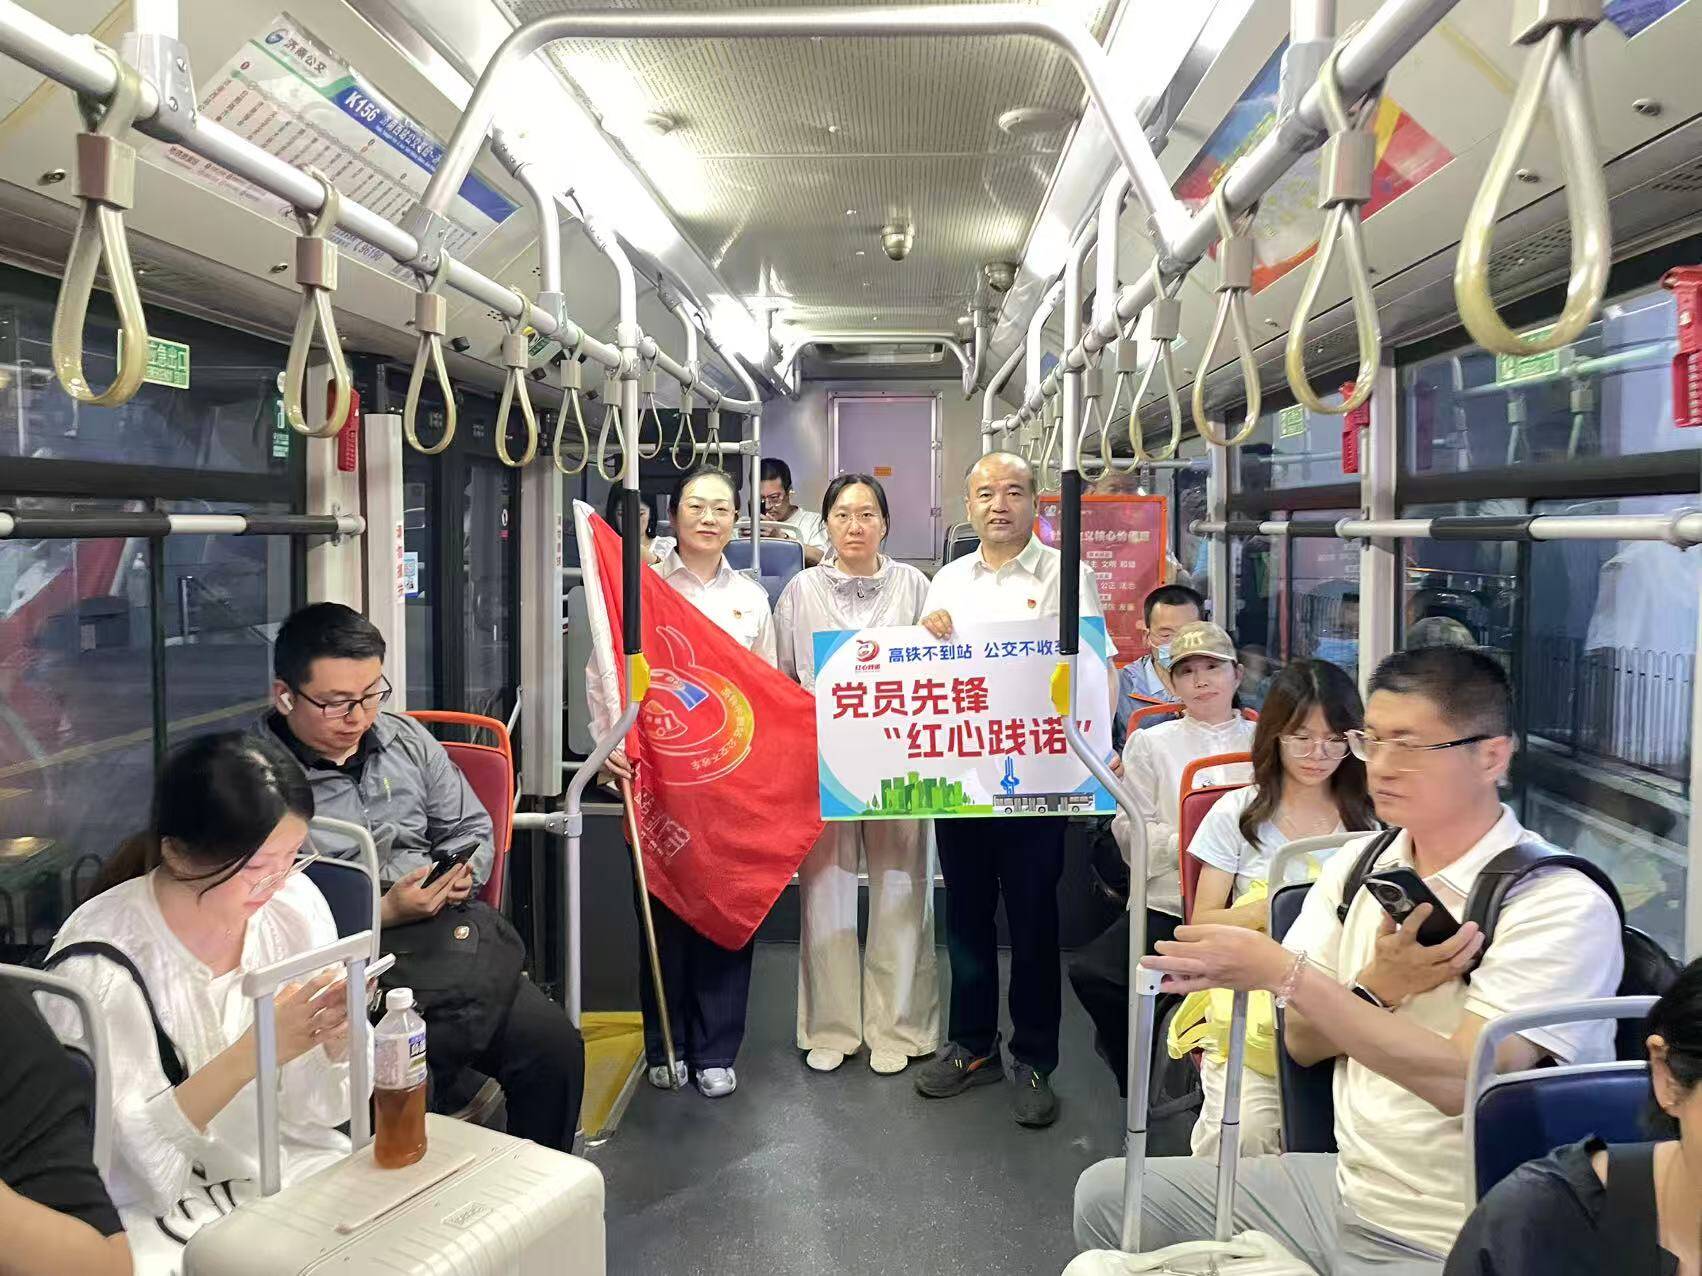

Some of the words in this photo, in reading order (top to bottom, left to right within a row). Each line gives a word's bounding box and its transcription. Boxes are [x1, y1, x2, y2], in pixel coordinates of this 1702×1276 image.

[344, 90, 381, 122] K156
[888, 644, 973, 663] 高铁不到站
[832, 676, 990, 719] 党员先锋
